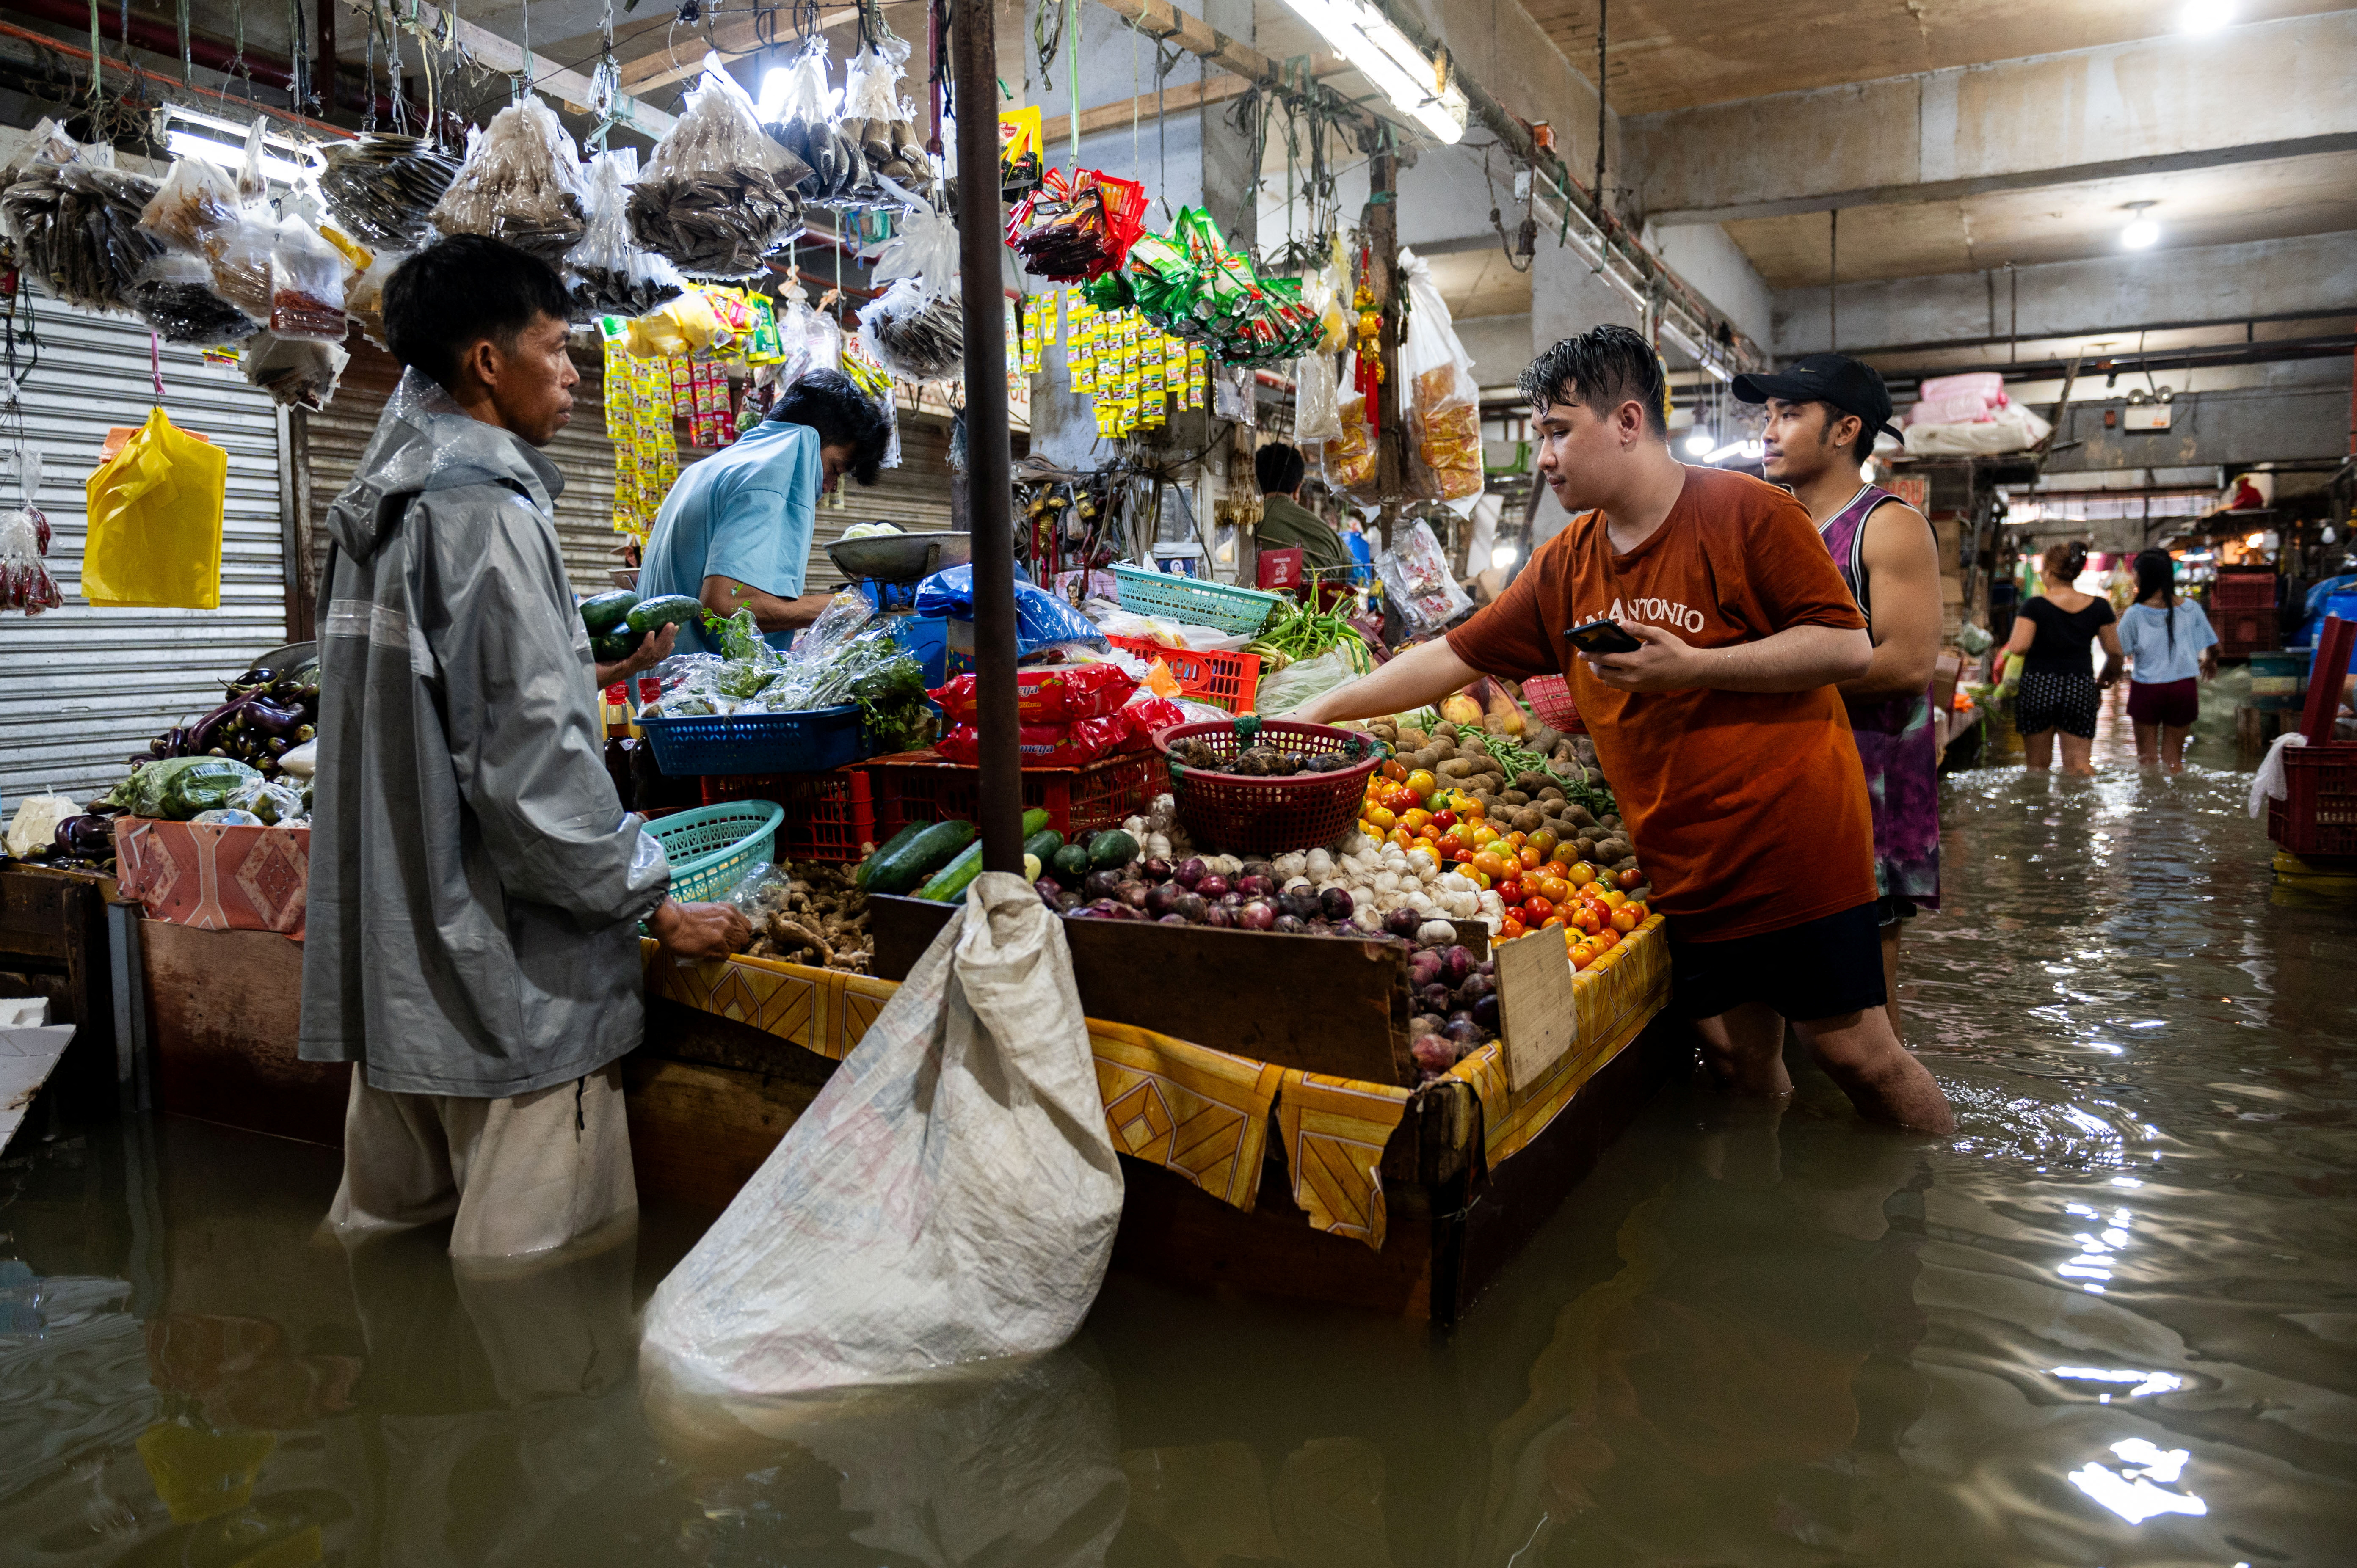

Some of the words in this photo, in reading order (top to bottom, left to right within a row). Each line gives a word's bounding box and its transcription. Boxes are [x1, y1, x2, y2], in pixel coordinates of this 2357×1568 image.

[1609, 598, 1704, 633] ANTONIO
[1018, 686, 1040, 697] eya
[1020, 745, 1054, 756] meya
